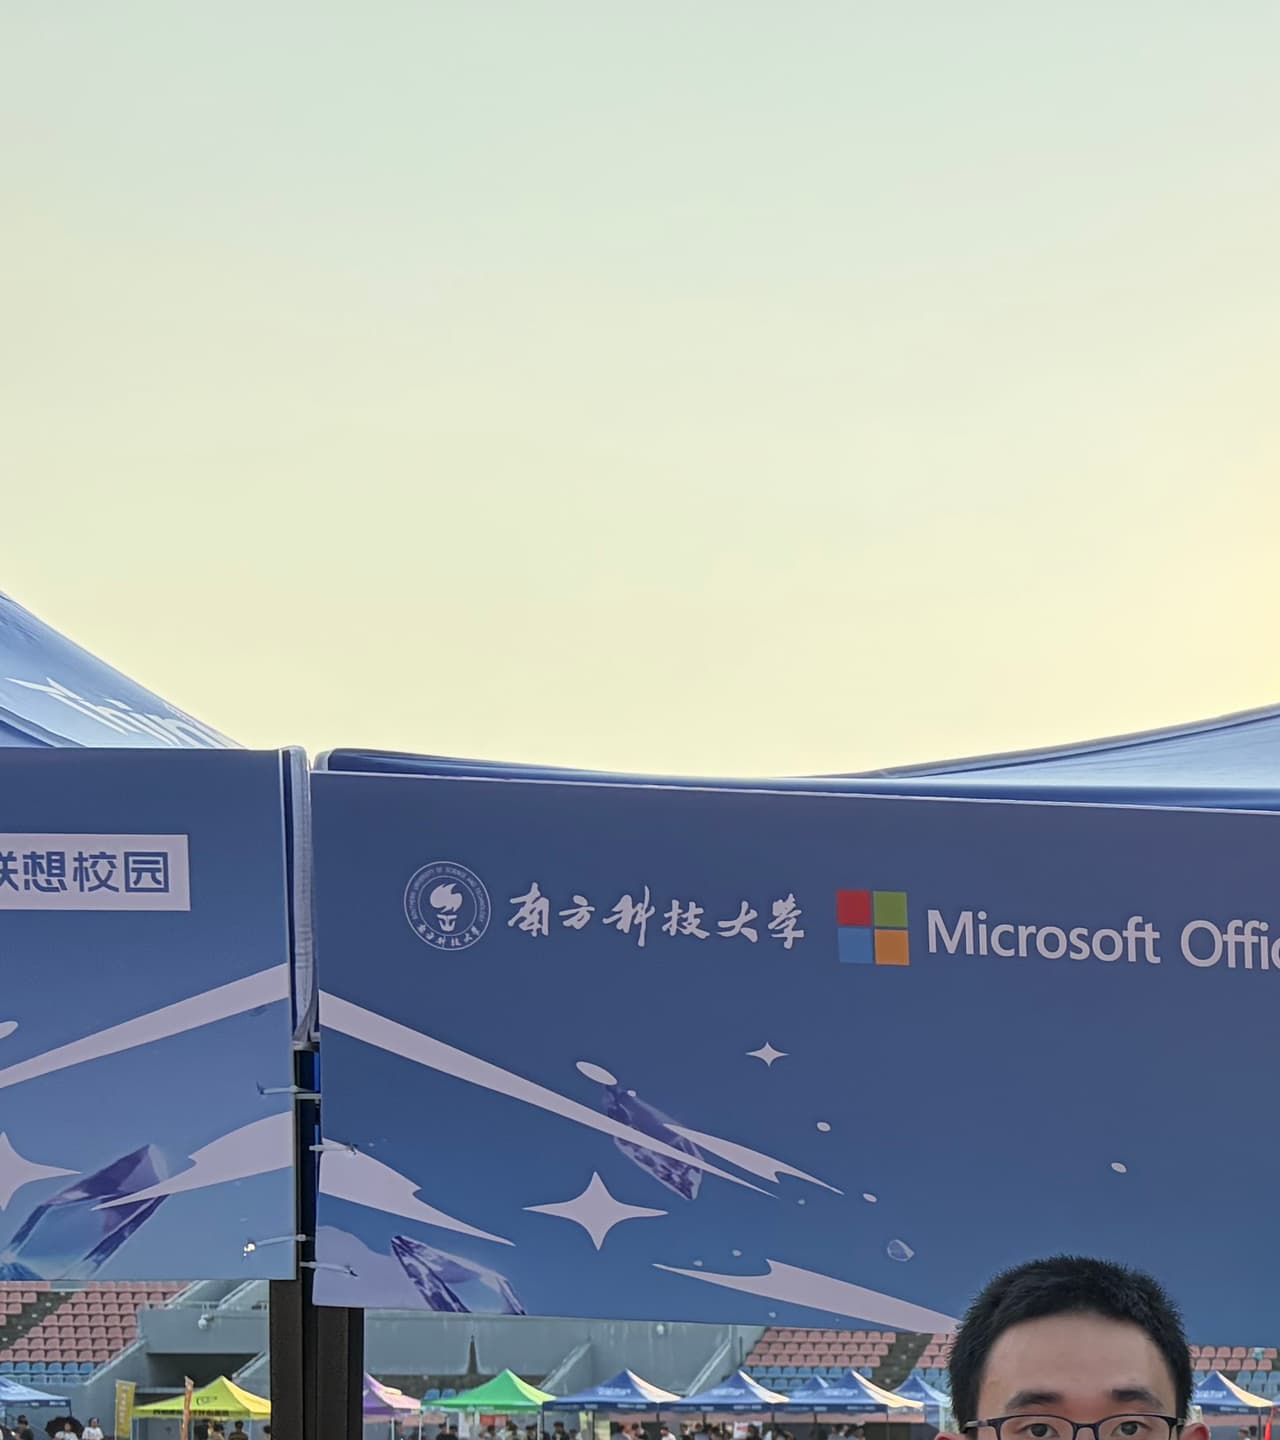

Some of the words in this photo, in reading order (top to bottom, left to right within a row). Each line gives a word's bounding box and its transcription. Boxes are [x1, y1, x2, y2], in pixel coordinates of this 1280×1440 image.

[507, 882, 804, 948] 南方科技大学
[926, 909, 1160, 964] Microsoft
